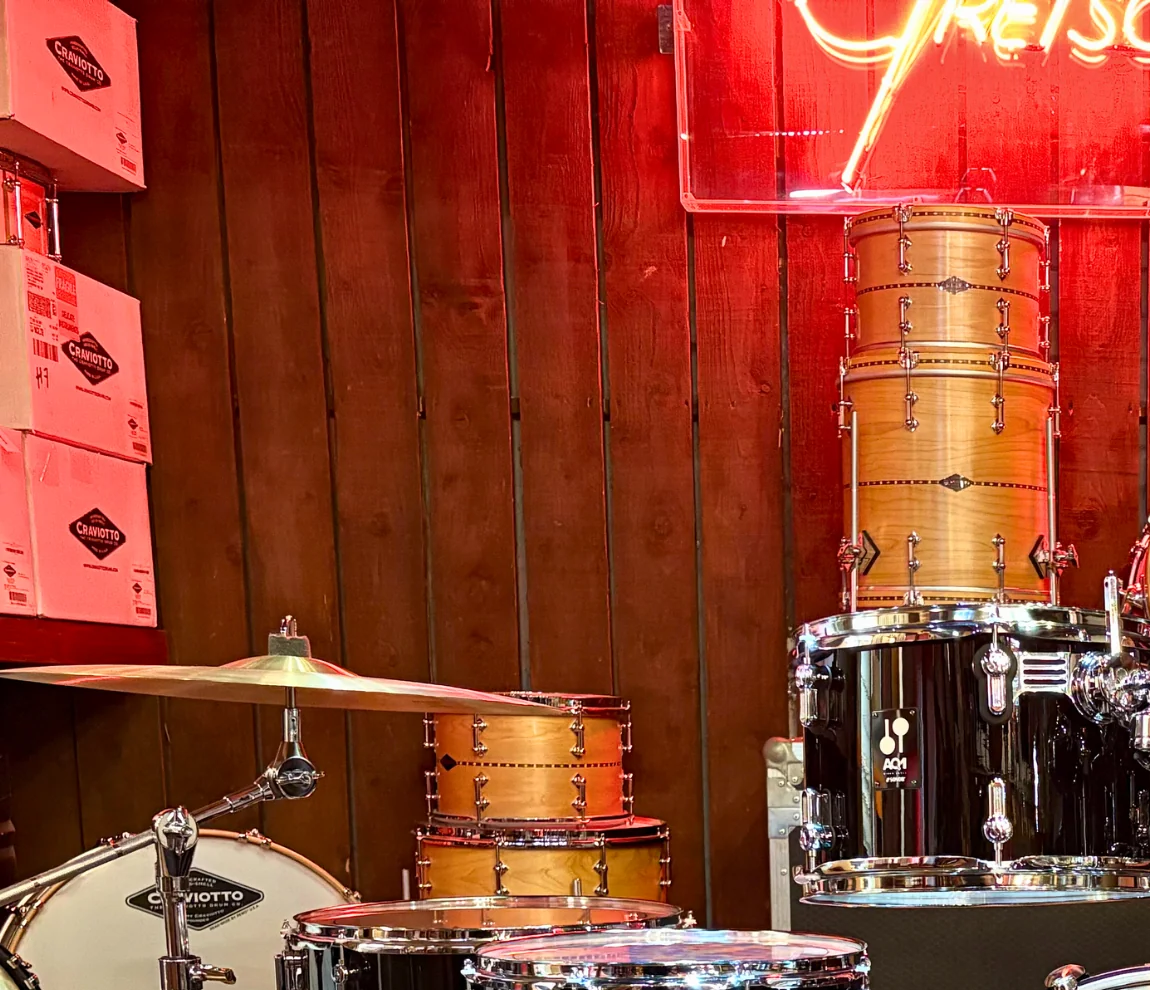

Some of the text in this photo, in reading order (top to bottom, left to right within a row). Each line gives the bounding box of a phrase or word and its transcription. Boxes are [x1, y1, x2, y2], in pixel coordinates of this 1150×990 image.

[54, 40, 104, 81] CRAVIOTTO
[68, 341, 113, 370] CRAVIOTTO
[75, 521, 120, 541] CRAVIOTTO
[882, 757, 907, 772] AQ1
[147, 890, 244, 905] CVIOTTO
